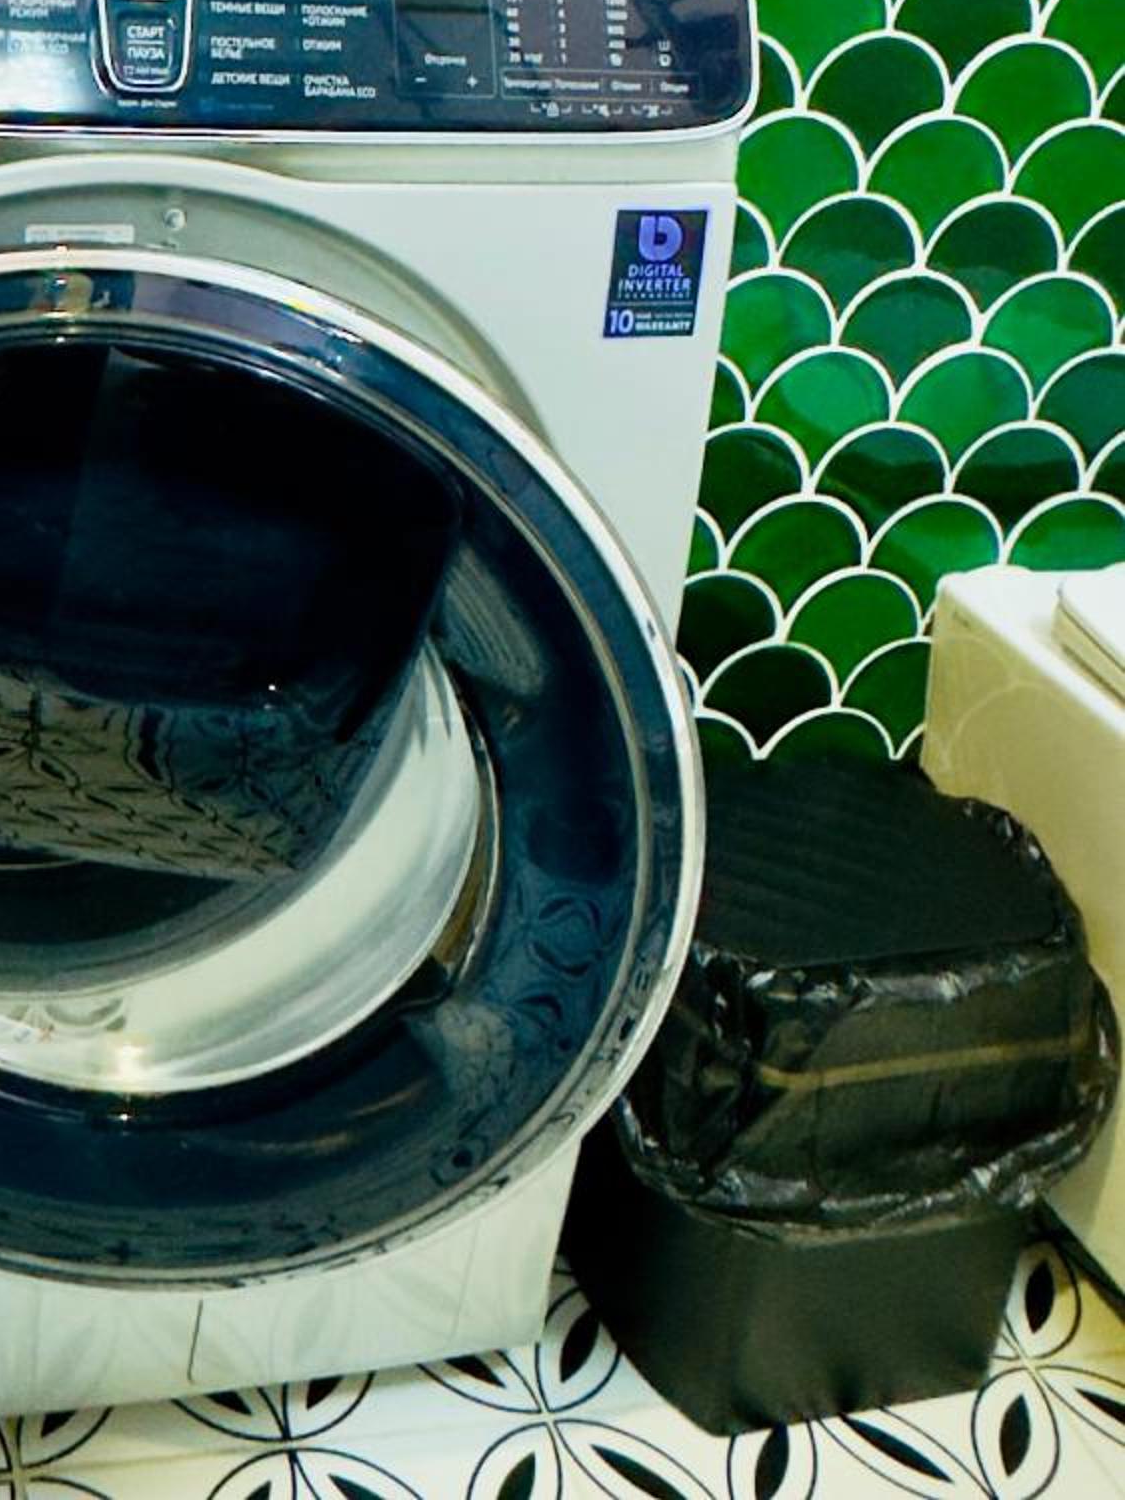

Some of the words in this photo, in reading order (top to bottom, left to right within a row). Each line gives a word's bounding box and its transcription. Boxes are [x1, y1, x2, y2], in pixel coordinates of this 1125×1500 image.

[126, 25, 165, 39] СТАРТ
[126, 46, 166, 60] ПАУЗА
[628, 263, 684, 278] DIGITAL
[618, 277, 692, 293] INVERTER
[609, 309, 634, 334] 10
